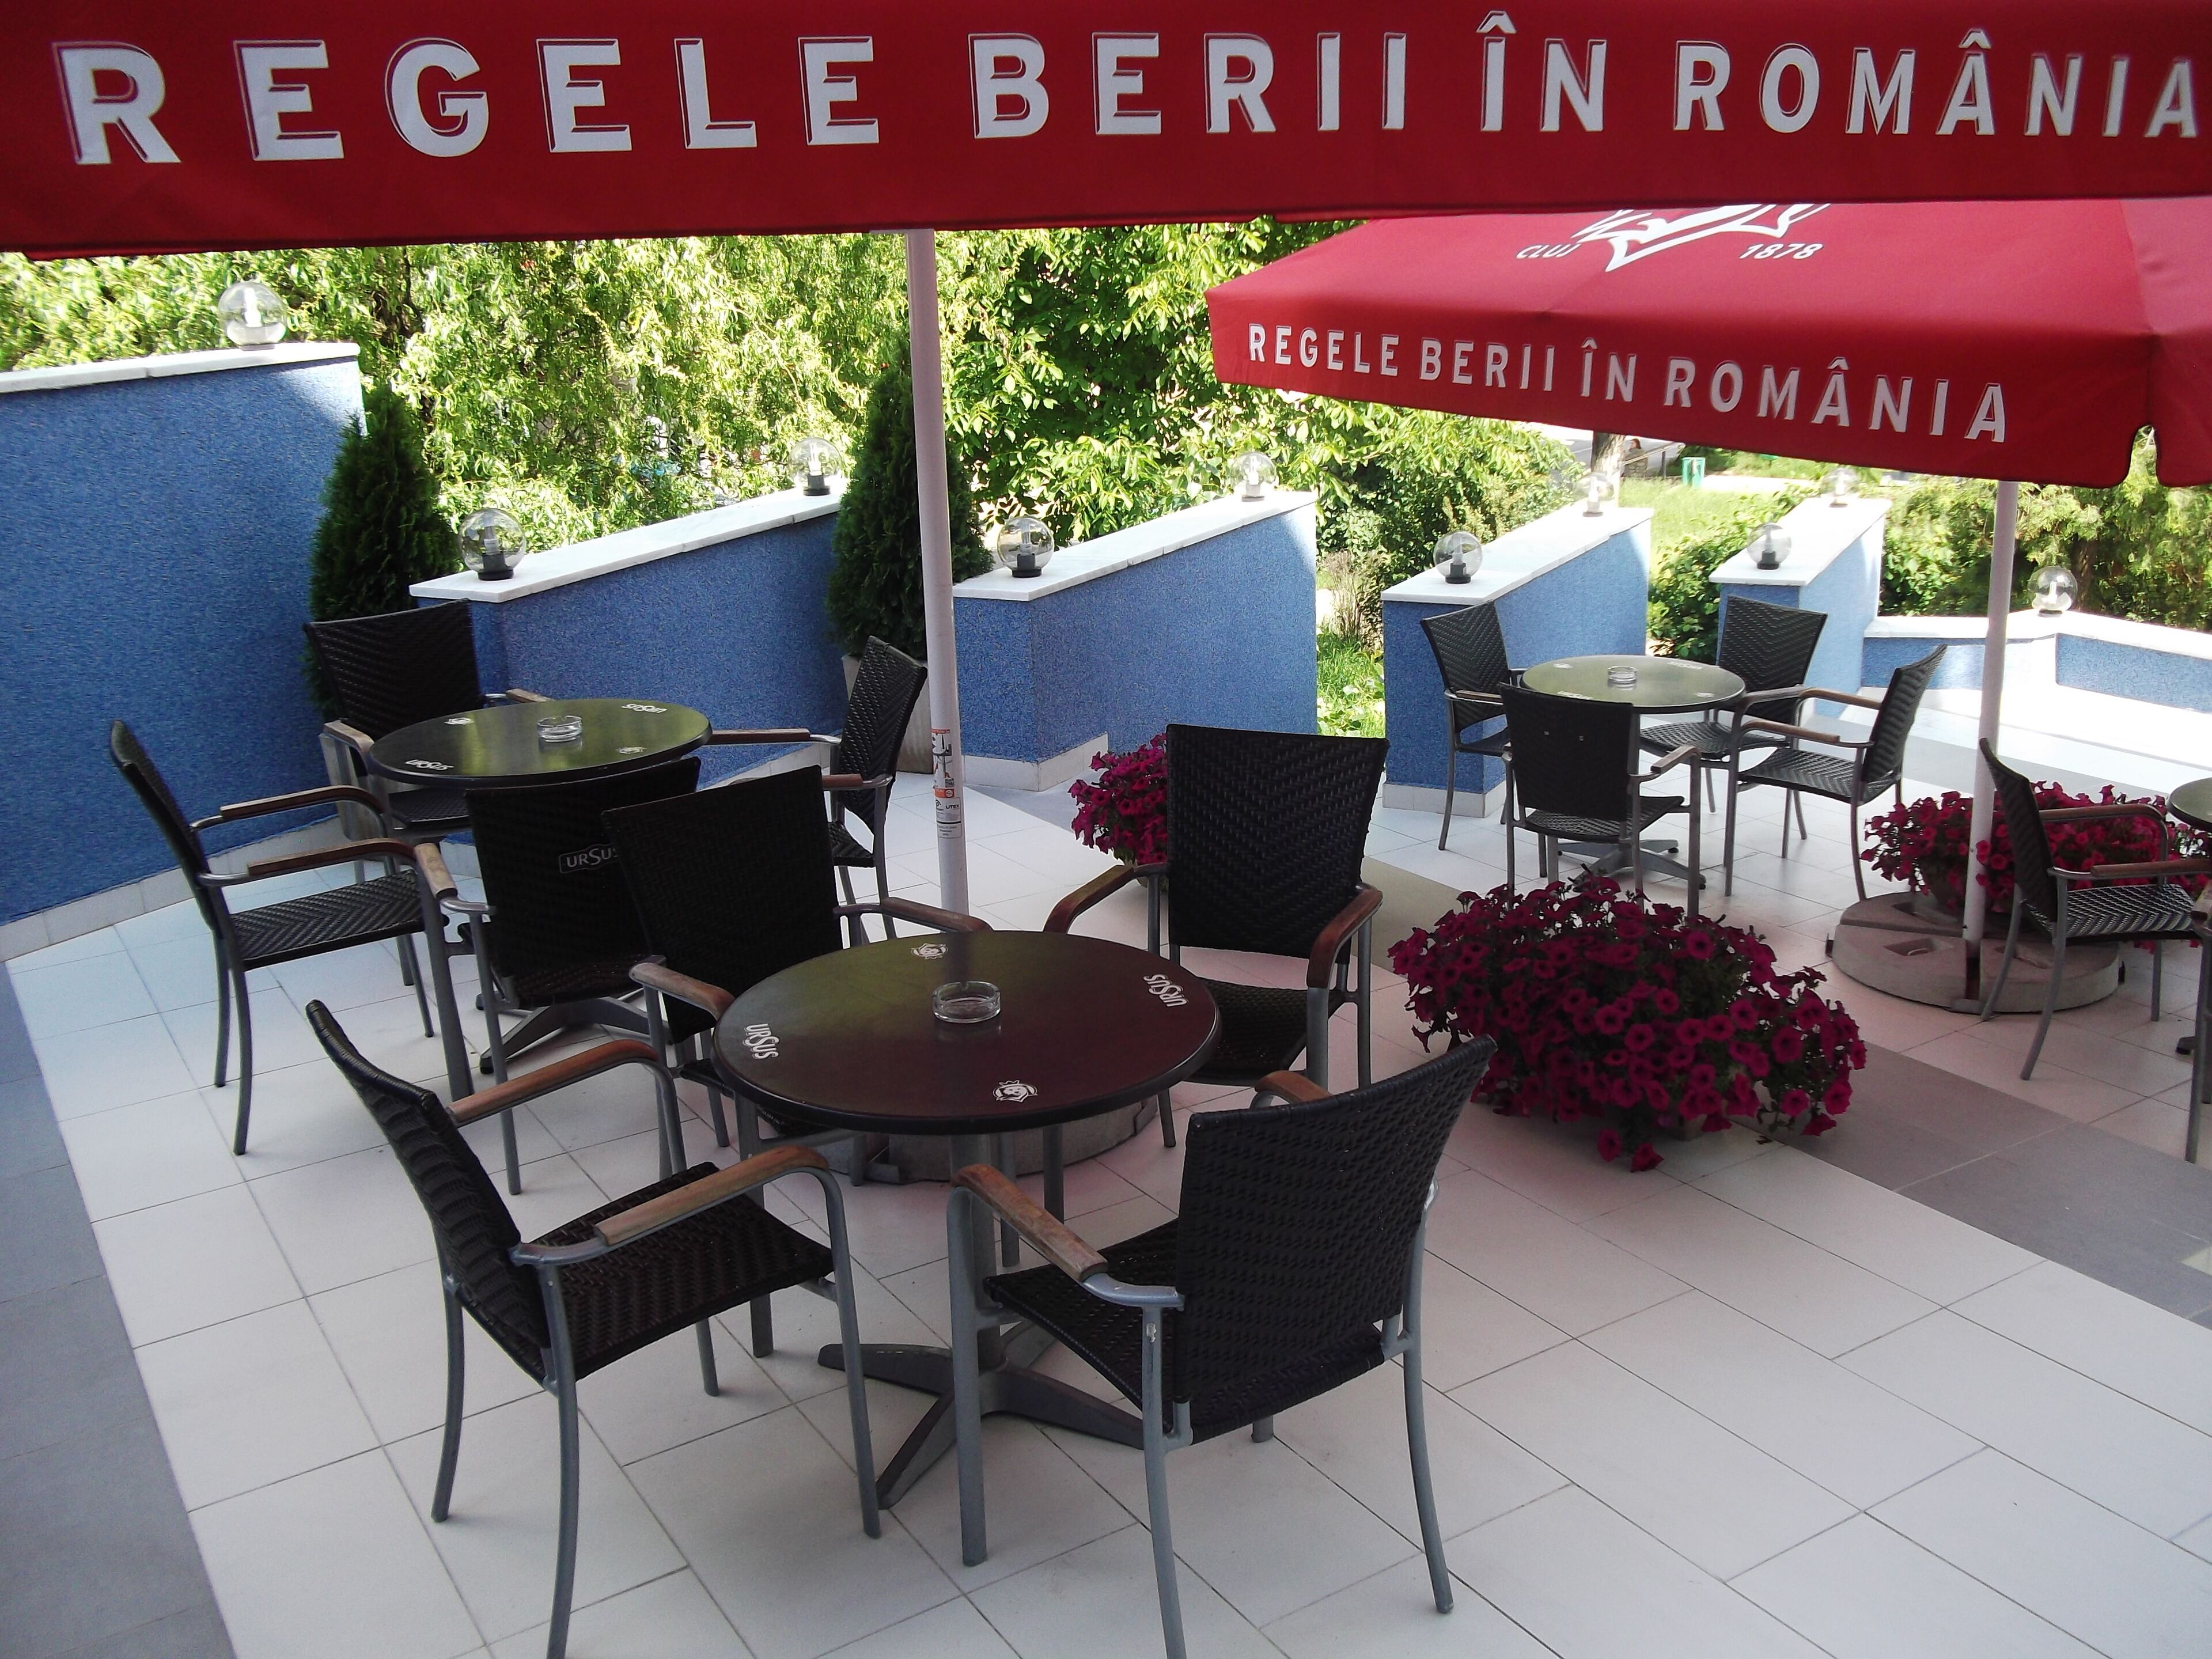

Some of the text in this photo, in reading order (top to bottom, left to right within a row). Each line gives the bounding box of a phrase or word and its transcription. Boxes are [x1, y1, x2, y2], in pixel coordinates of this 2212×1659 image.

[52, 11, 2197, 165] REGELE BERII ÎN ROMÂNIA
[1516, 243, 1581, 259] CLUJ
[1738, 243, 1824, 259] 1878
[1248, 323, 2006, 442] REGELE BERII ÎN ROMÂNIA
[1143, 974, 1189, 1007] URSUS
[742, 1023, 780, 1059] URSUS
